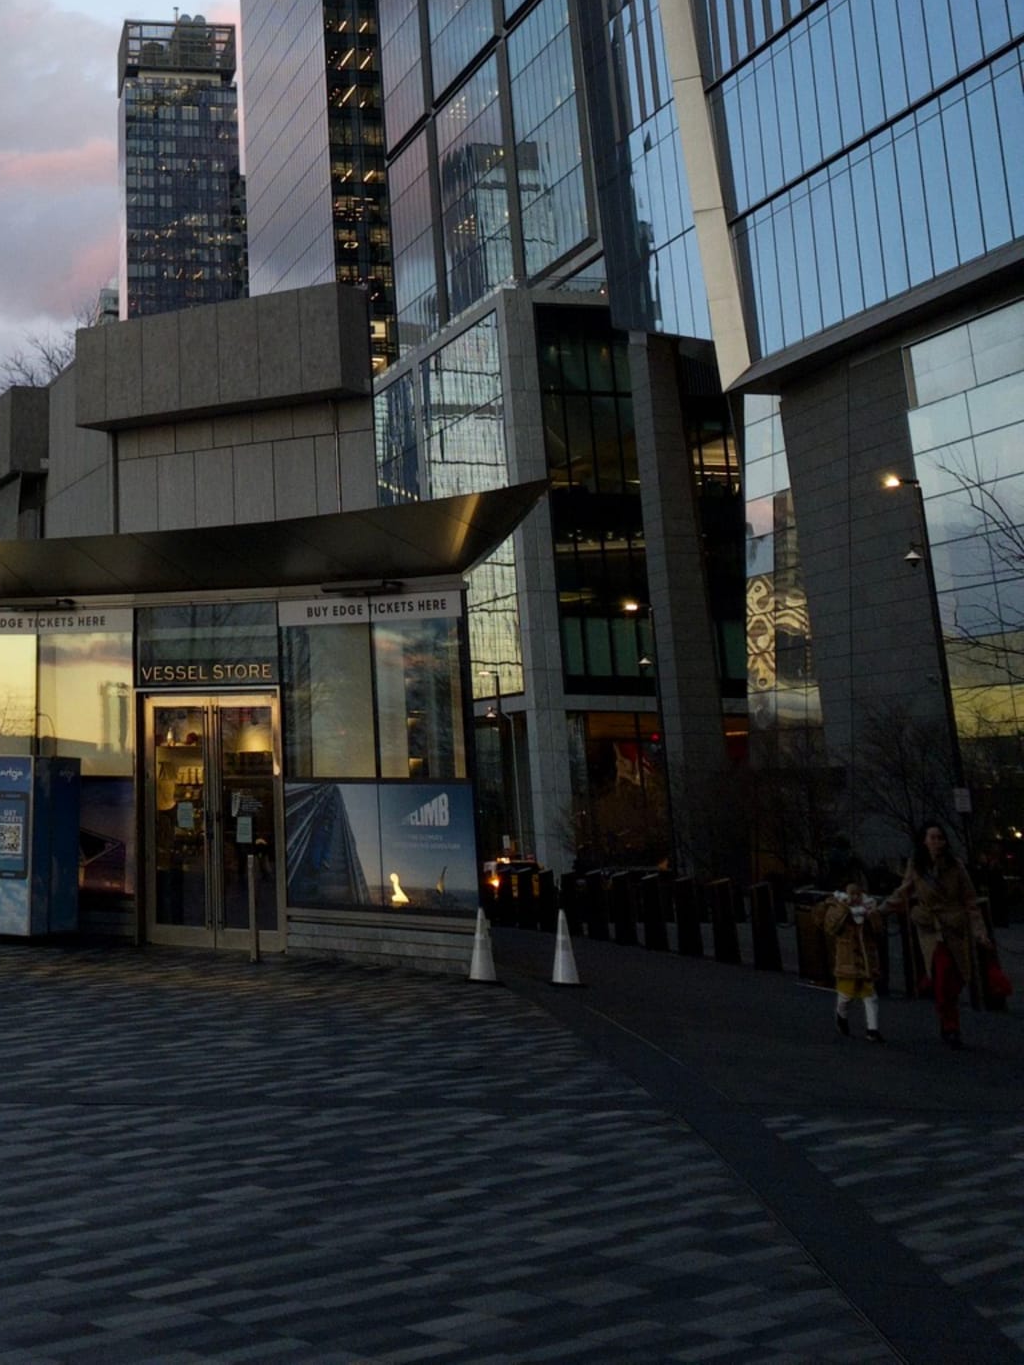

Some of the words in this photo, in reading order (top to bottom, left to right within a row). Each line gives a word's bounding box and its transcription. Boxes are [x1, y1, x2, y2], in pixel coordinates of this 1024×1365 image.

[306, 606, 328, 618] BUY
[332, 604, 363, 616] EDGE
[368, 601, 414, 614] TICKETS
[418, 598, 447, 611] HERE
[27, 616, 74, 628] TICKETS
[78, 615, 106, 626] HERE
[141, 665, 209, 681] VESSEL
[212, 663, 273, 680] STORE
